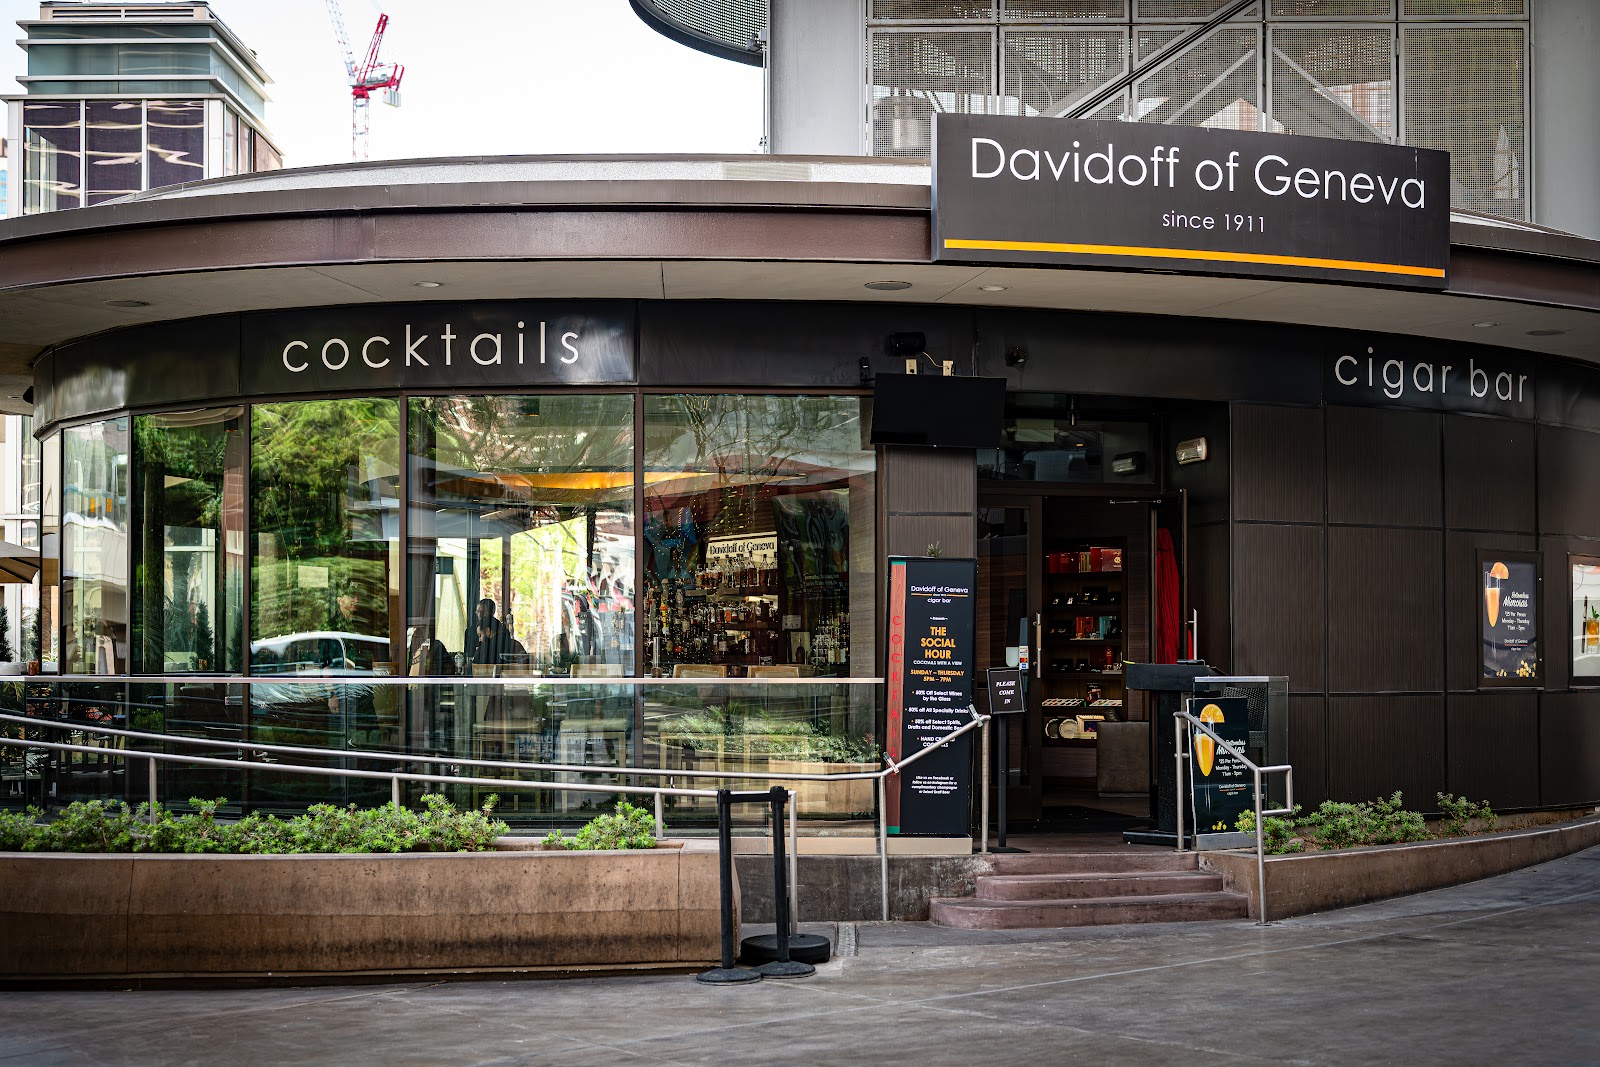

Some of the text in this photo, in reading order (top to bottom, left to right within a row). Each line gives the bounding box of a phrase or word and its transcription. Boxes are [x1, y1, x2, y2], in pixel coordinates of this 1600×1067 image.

[971, 137, 1425, 209] Davidoff of Geneva
[1162, 210, 1264, 232] since 1911
[282, 320, 579, 372] cocktails
[1335, 346, 1527, 402] cigar bar
[709, 542, 774, 555] Davidoff of Geneva
[930, 626, 947, 636] THE
[921, 638, 956, 648] SOCIAL
[924, 649, 951, 659] HOUR
